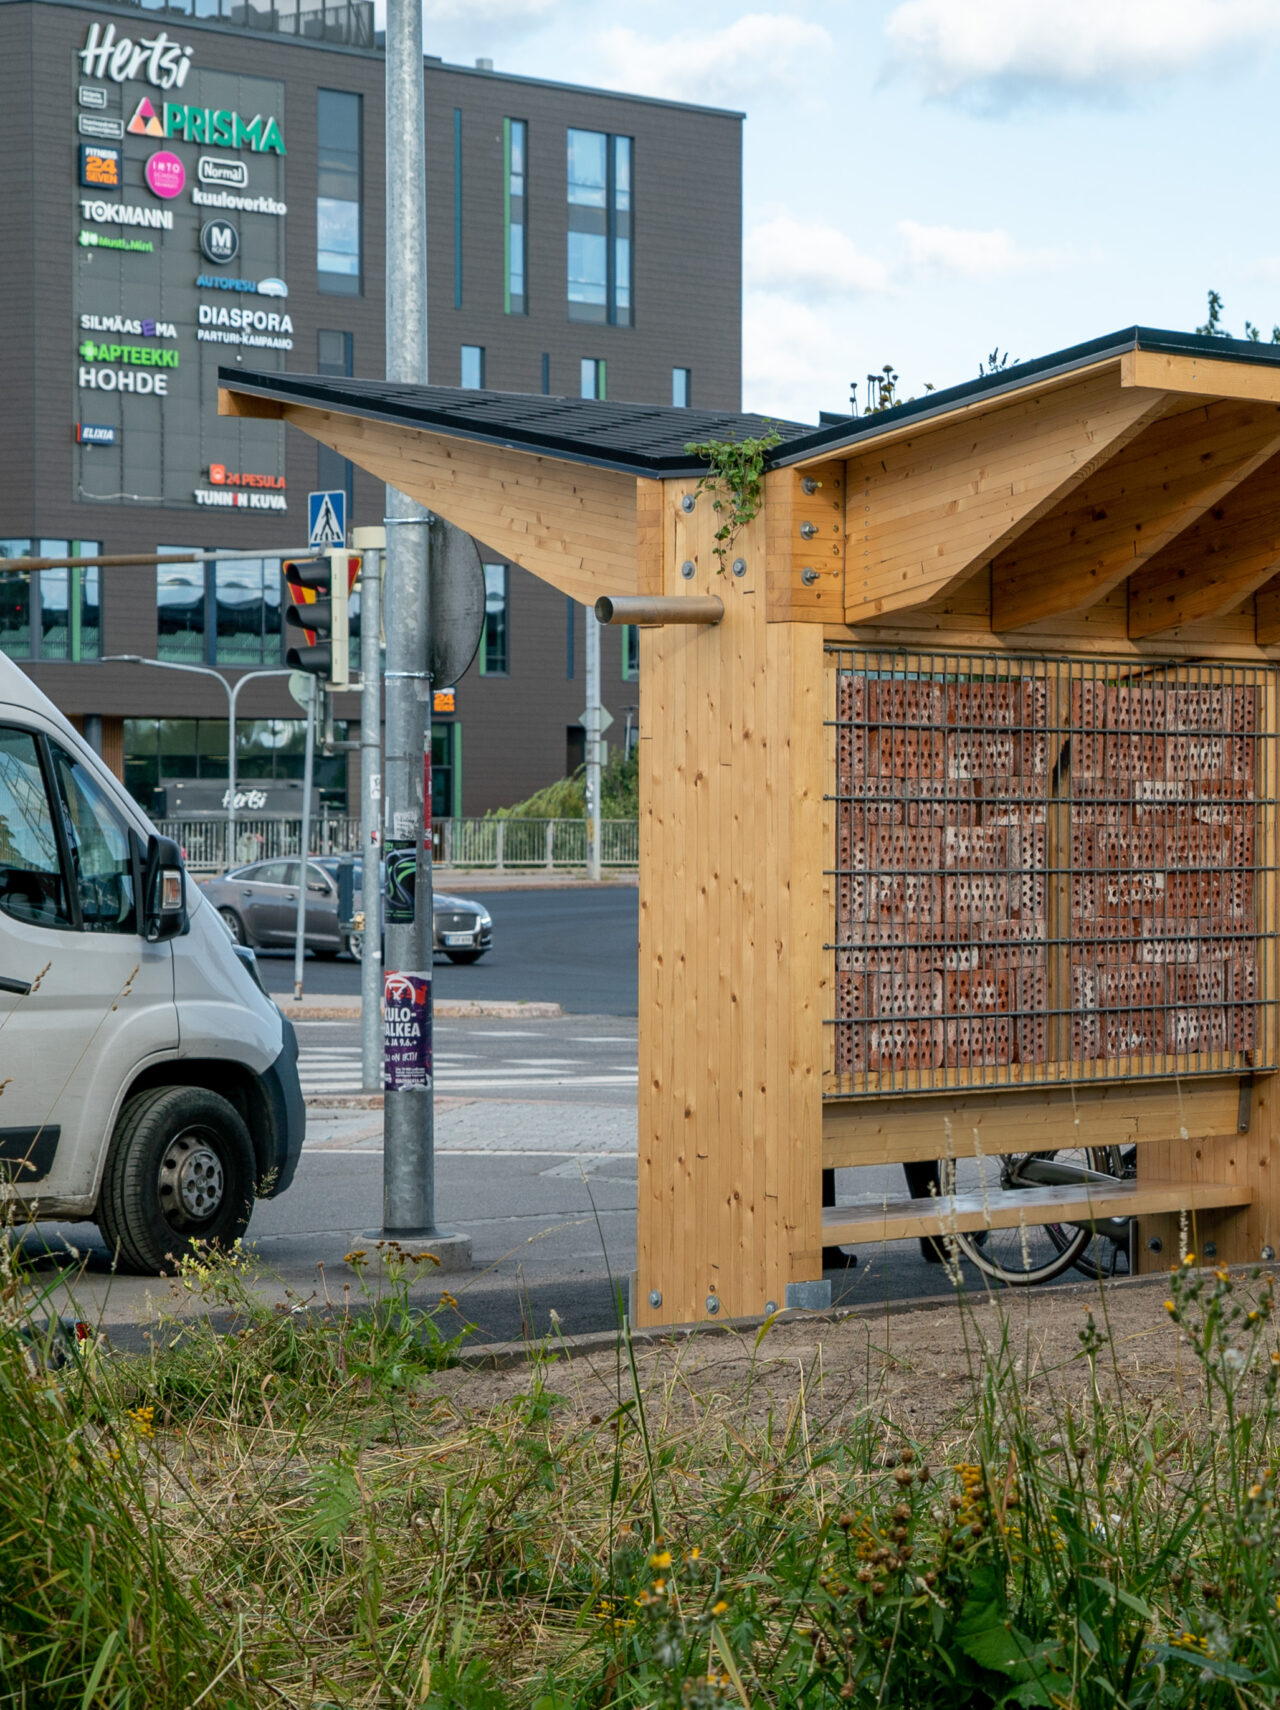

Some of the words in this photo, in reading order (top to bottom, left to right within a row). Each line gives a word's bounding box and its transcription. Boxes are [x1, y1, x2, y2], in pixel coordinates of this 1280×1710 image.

[79, 22, 194, 90] Hertsi
[162, 102, 287, 155] PRISMA
[86, 147, 118, 159] FITNESS
[86, 157, 117, 174] 24
[153, 162, 180, 173] INTO
[203, 163, 243, 182] Normal
[86, 172, 118, 185] SEVEN
[192, 188, 288, 216] kuuloverkko
[80, 200, 174, 230] TOKMANNI
[212, 227, 232, 248] M
[196, 274, 257, 293] AUTOPESU
[80, 314, 178, 339] SILMÄASEMA
[199, 304, 294, 334] DIASPORA
[197, 329, 294, 351] PARTURI-KAMPAAMO
[96, 343, 179, 369] APTEEKKI
[79, 367, 169, 396] HOHDE
[82, 426, 114, 441] ELIXIA
[225, 472, 241, 485] 24
[241, 474, 287, 490] PESULA
[249, 493, 288, 511] KUVA
[433, 692, 455, 706] 24
